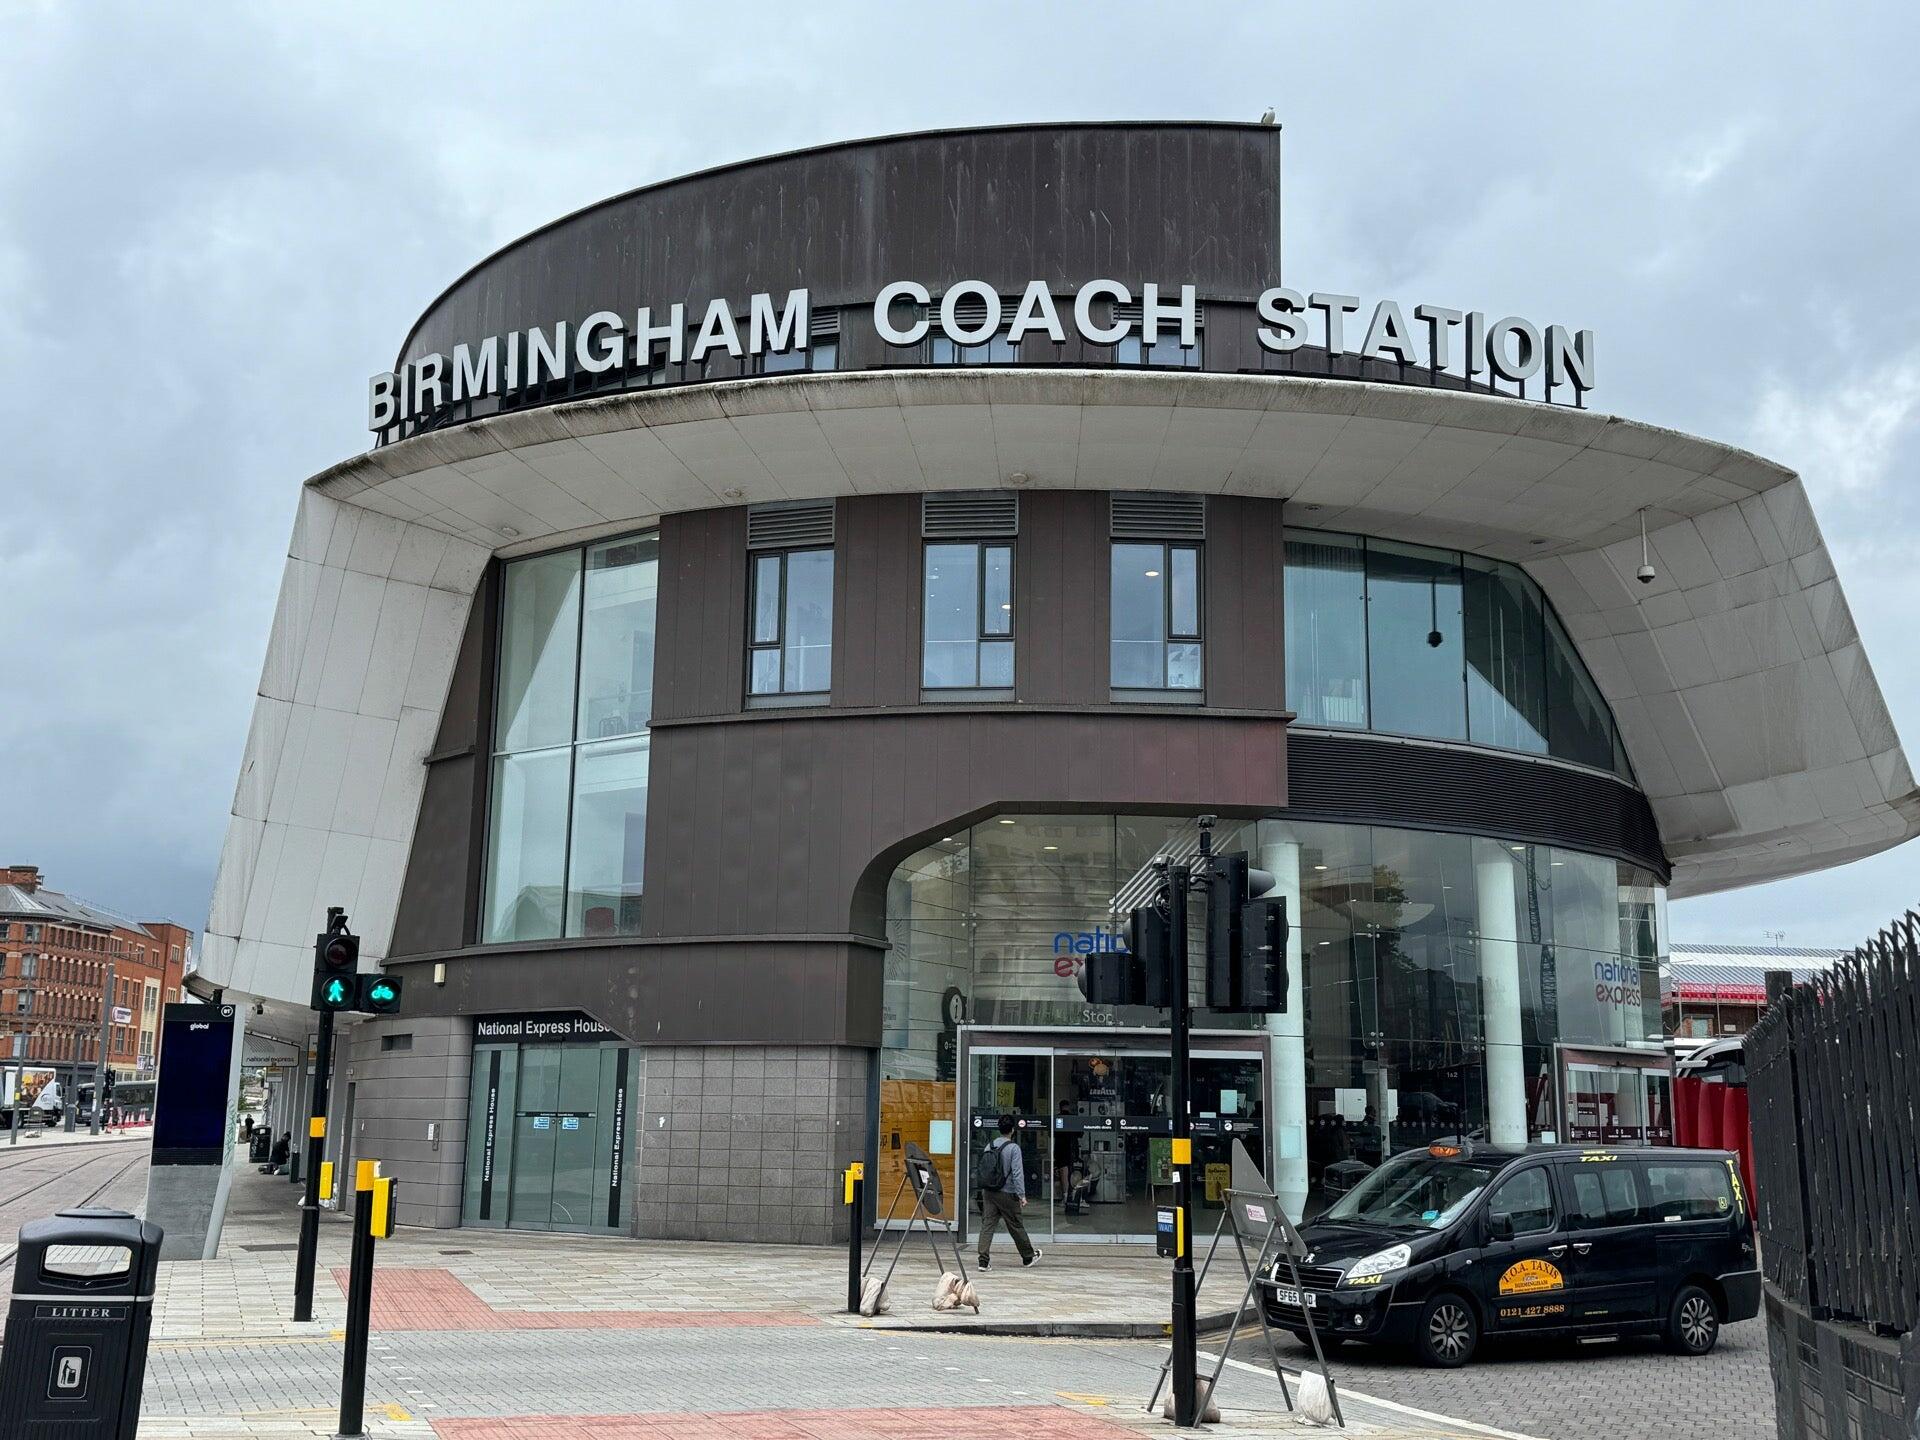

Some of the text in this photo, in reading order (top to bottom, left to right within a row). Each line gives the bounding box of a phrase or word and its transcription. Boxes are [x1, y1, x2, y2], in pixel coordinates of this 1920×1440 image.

[368, 278, 1595, 433] BIRMINGHAM COACH STATION
[1594, 956, 1640, 988] national
[1595, 983, 1641, 1011] express
[189, 1023, 210, 1031] global
[477, 1020, 522, 1036] National
[525, 1020, 571, 1037] Express
[486, 1115, 494, 1147] Express
[613, 1117, 622, 1150] Express
[484, 1148, 492, 1182] National
[611, 1152, 620, 1187] National
[1726, 1160, 1744, 1214] TAXI
[1158, 1222, 1173, 1232] WAIT
[1348, 1274, 1383, 1286] TAXI
[1531, 1260, 1559, 1280] TAXIS
[1279, 1289, 1297, 1303] SF65
[51, 1307, 110, 1318] LITTER
[1500, 1307, 1521, 1317] 0121
[1524, 1306, 1541, 1314] 427
[1543, 1304, 1565, 1314] 8888
